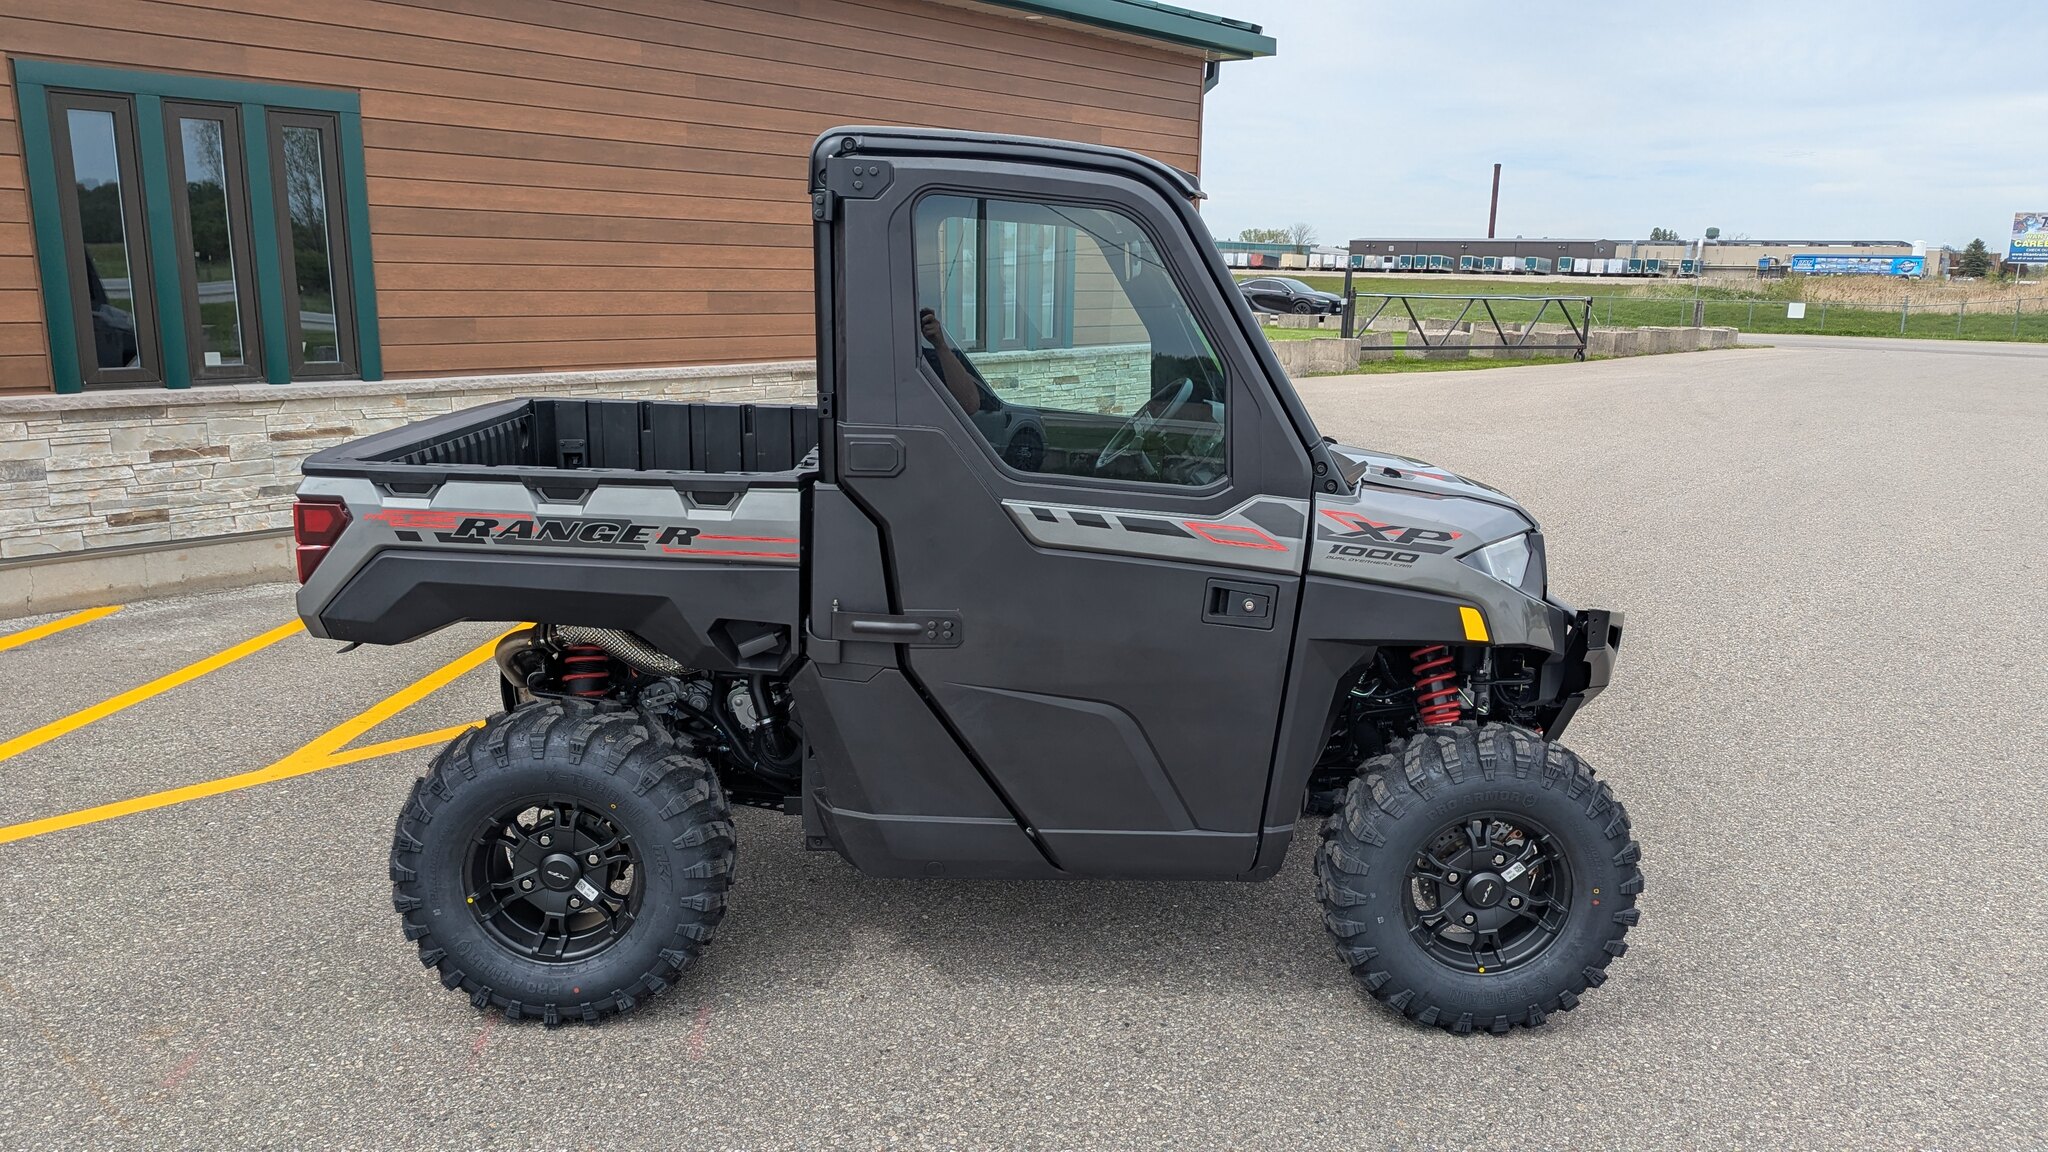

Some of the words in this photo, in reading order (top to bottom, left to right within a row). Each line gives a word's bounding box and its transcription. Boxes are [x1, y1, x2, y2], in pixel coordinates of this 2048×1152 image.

[449, 517, 702, 547] RANGER
[1333, 520, 1454, 544] XP
[1328, 544, 1420, 563] 1000
[1347, 557, 1393, 566] OVERHEAD
